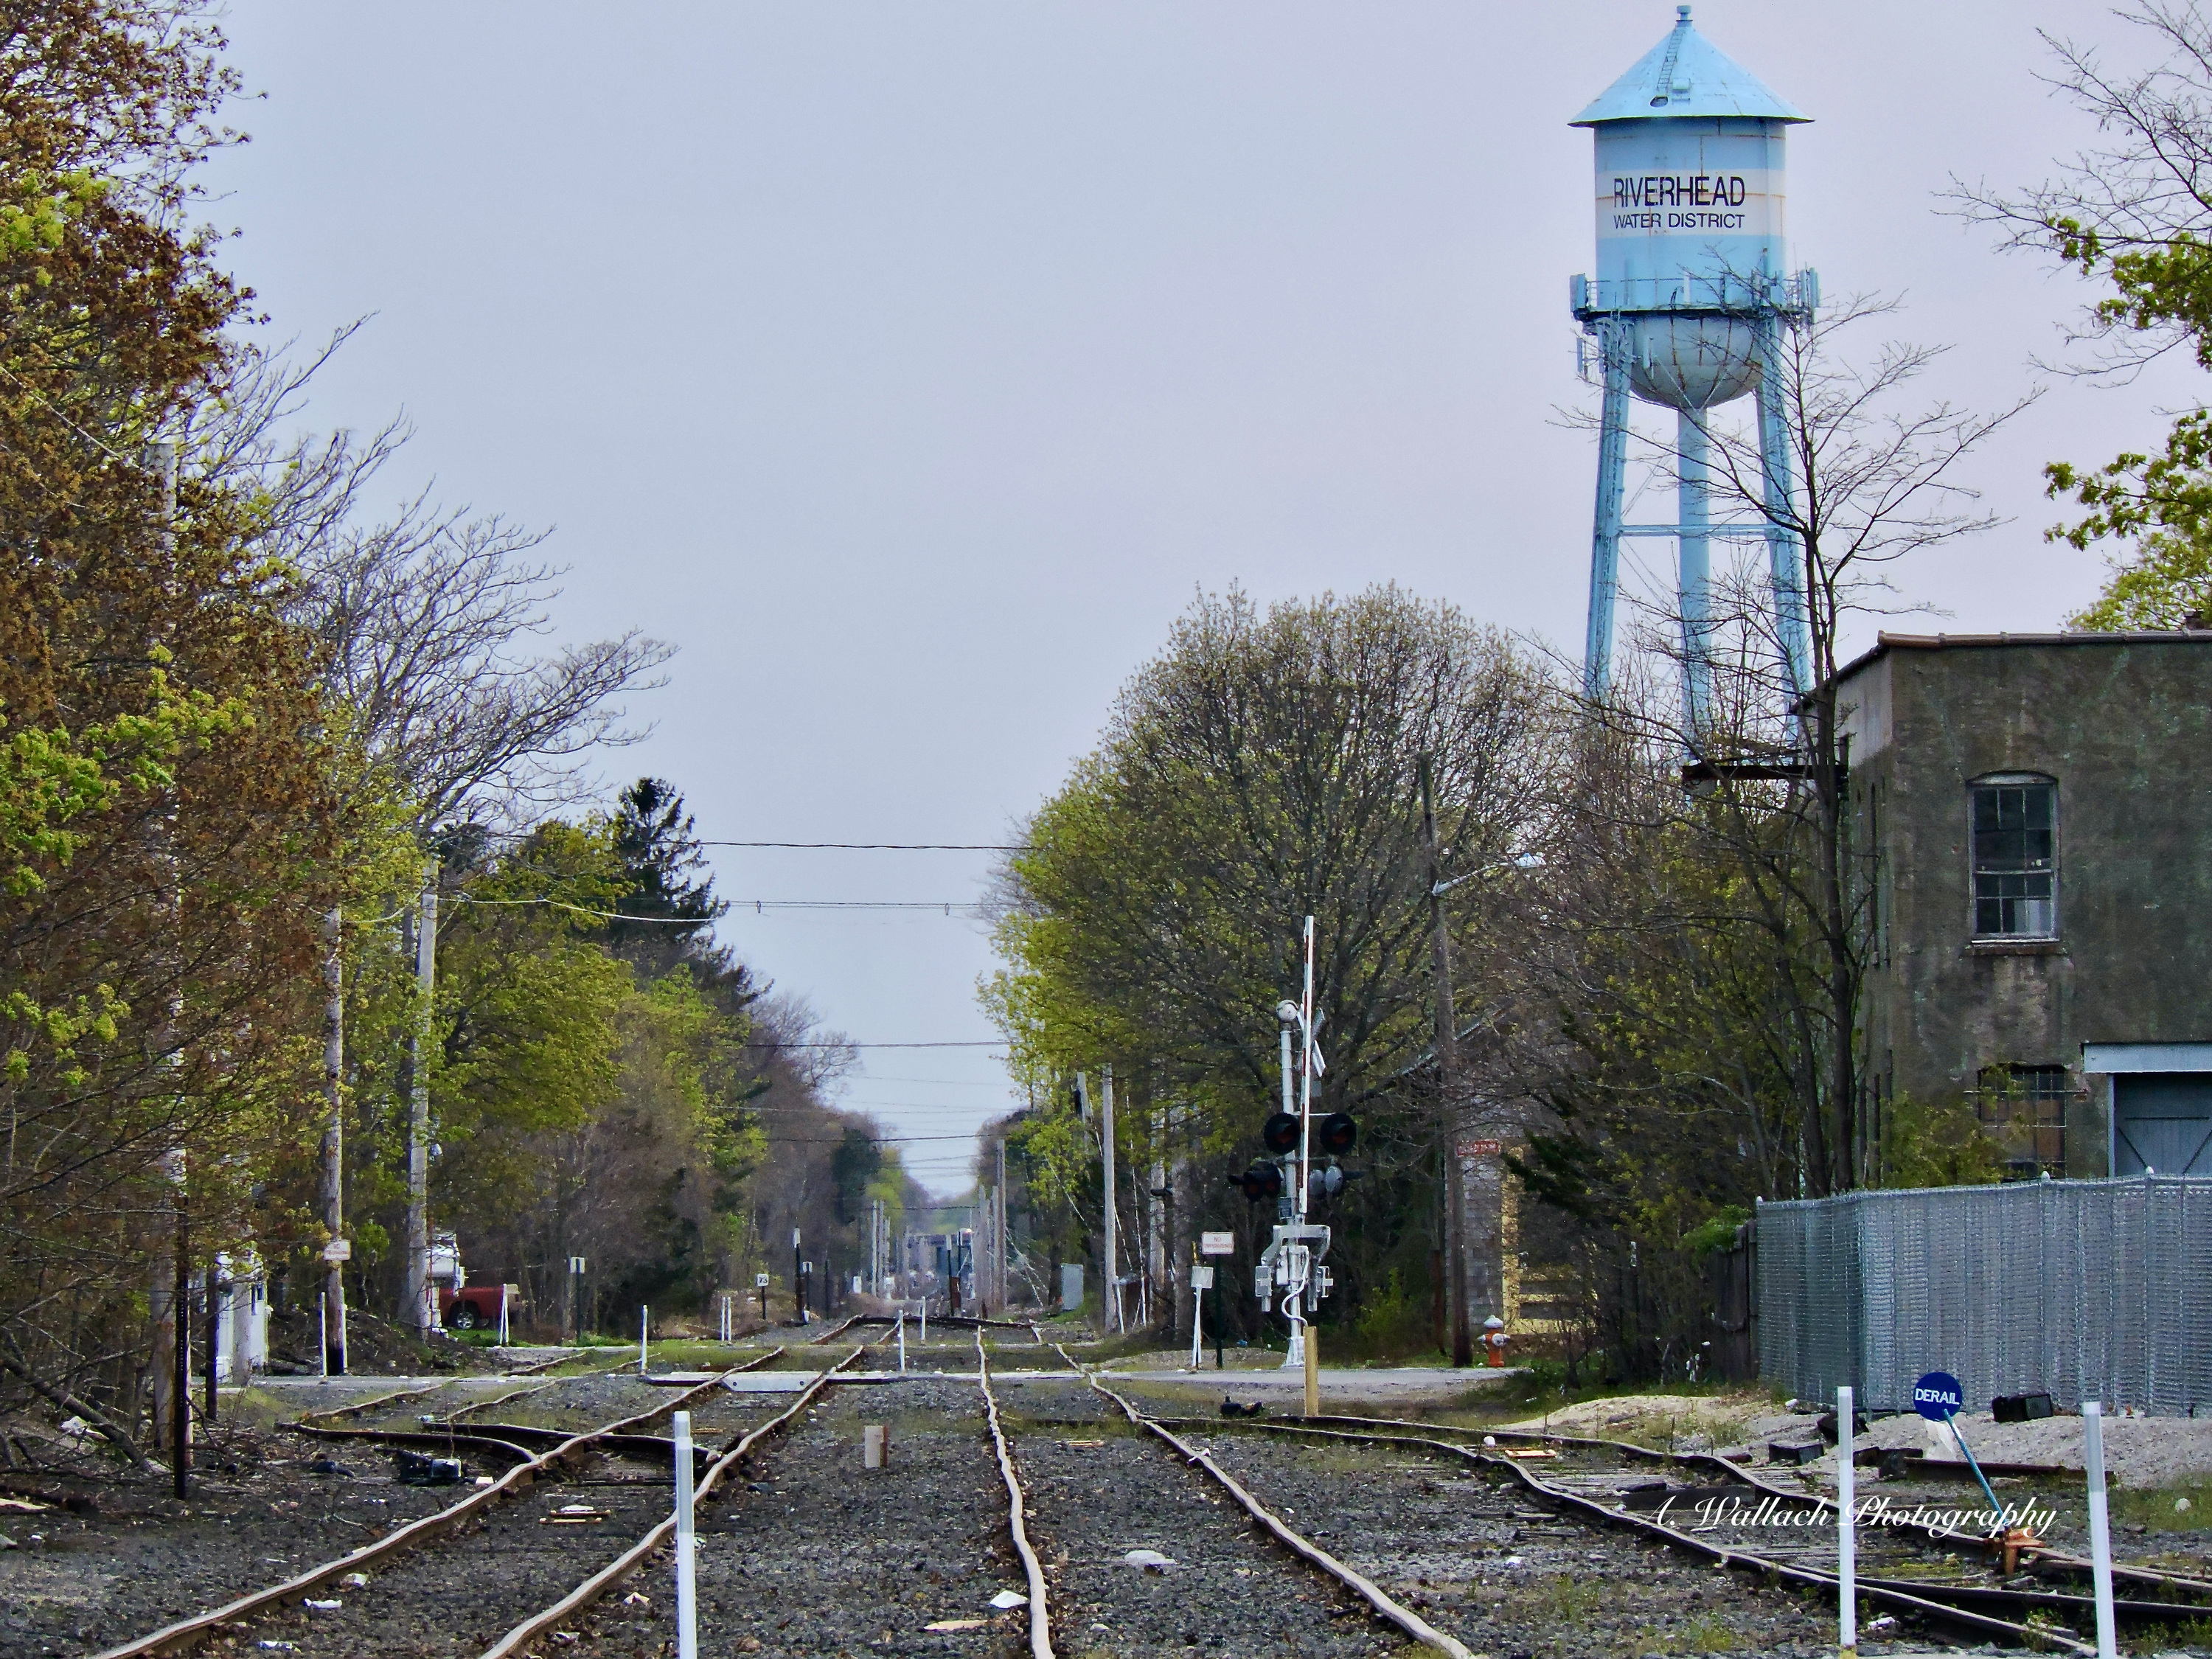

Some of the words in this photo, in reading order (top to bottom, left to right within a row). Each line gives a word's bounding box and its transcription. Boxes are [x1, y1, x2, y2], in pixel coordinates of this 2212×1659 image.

[1613, 176, 1745, 208] RIVERHEAD
[1613, 213, 1662, 229] WATER
[1668, 213, 1745, 229] DISTRICT
[1915, 1388, 1960, 1405] DERAIL
